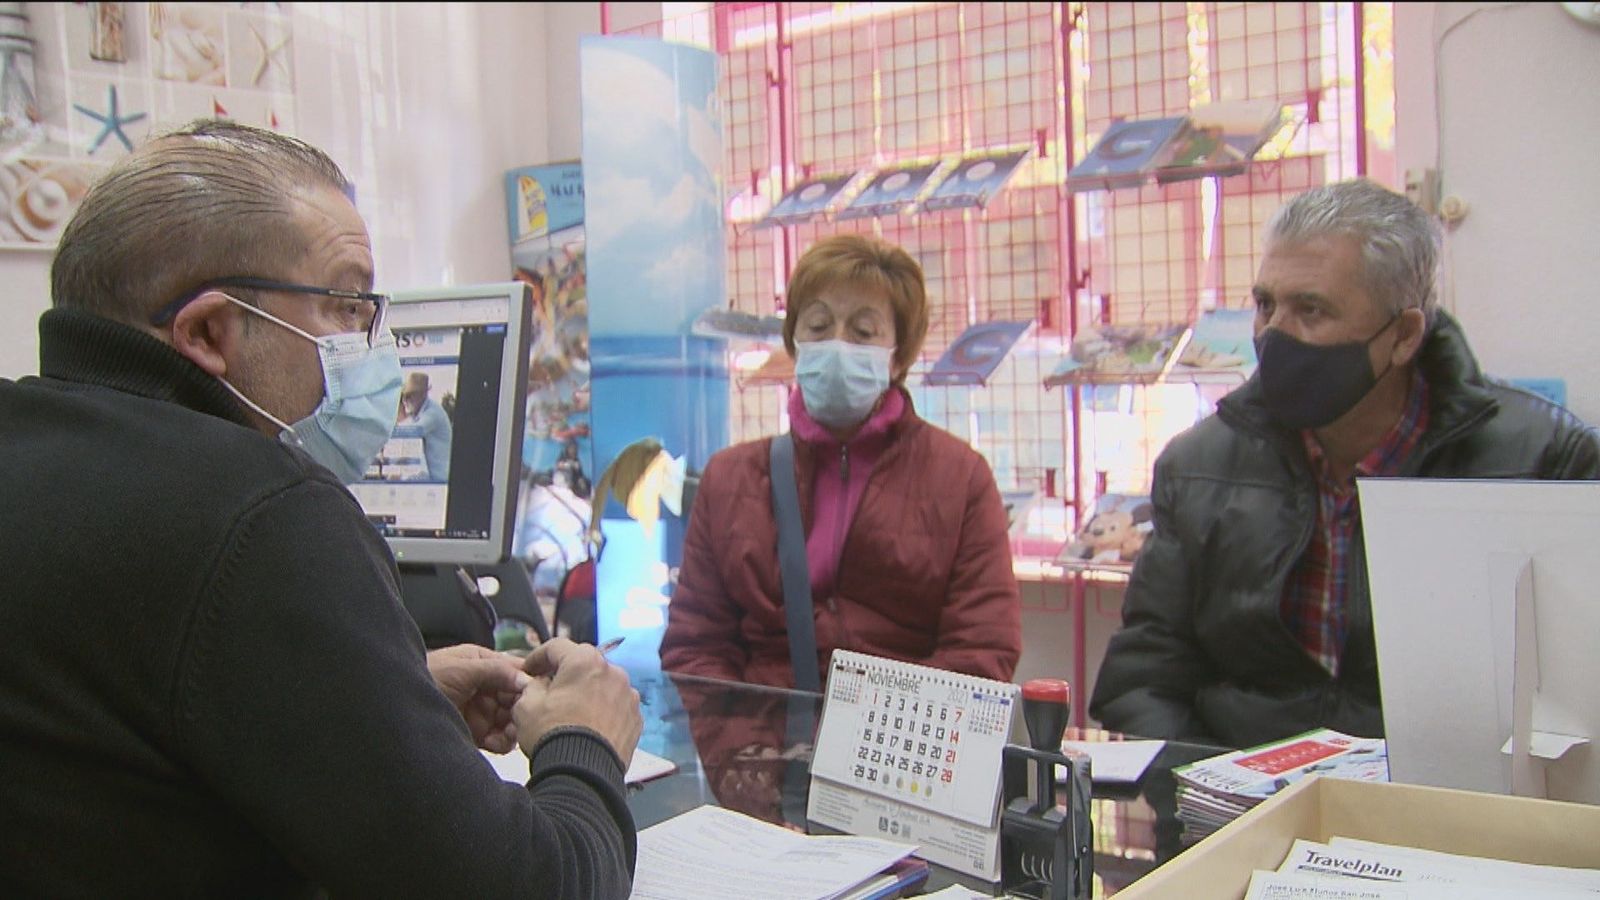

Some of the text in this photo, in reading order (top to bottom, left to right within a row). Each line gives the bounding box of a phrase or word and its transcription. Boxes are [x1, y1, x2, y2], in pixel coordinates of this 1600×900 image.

[868, 671, 921, 694] NOVIEMBRE
[873, 692, 878, 705] 1
[884, 695, 891, 707] 2
[899, 698, 905, 711] 3
[912, 702, 919, 714] 4
[926, 704, 933, 718] 5
[940, 708, 947, 721] 6
[955, 711, 962, 723] 7
[868, 710, 959, 744] 8 9 10 11 12 13 14
[863, 728, 956, 763] 15 16 17 18 19 20 21
[854, 764, 878, 781] 29 30
[857, 746, 953, 783] 22 23 24 25 26 27 28
[1305, 849, 1403, 878] Travelplan
